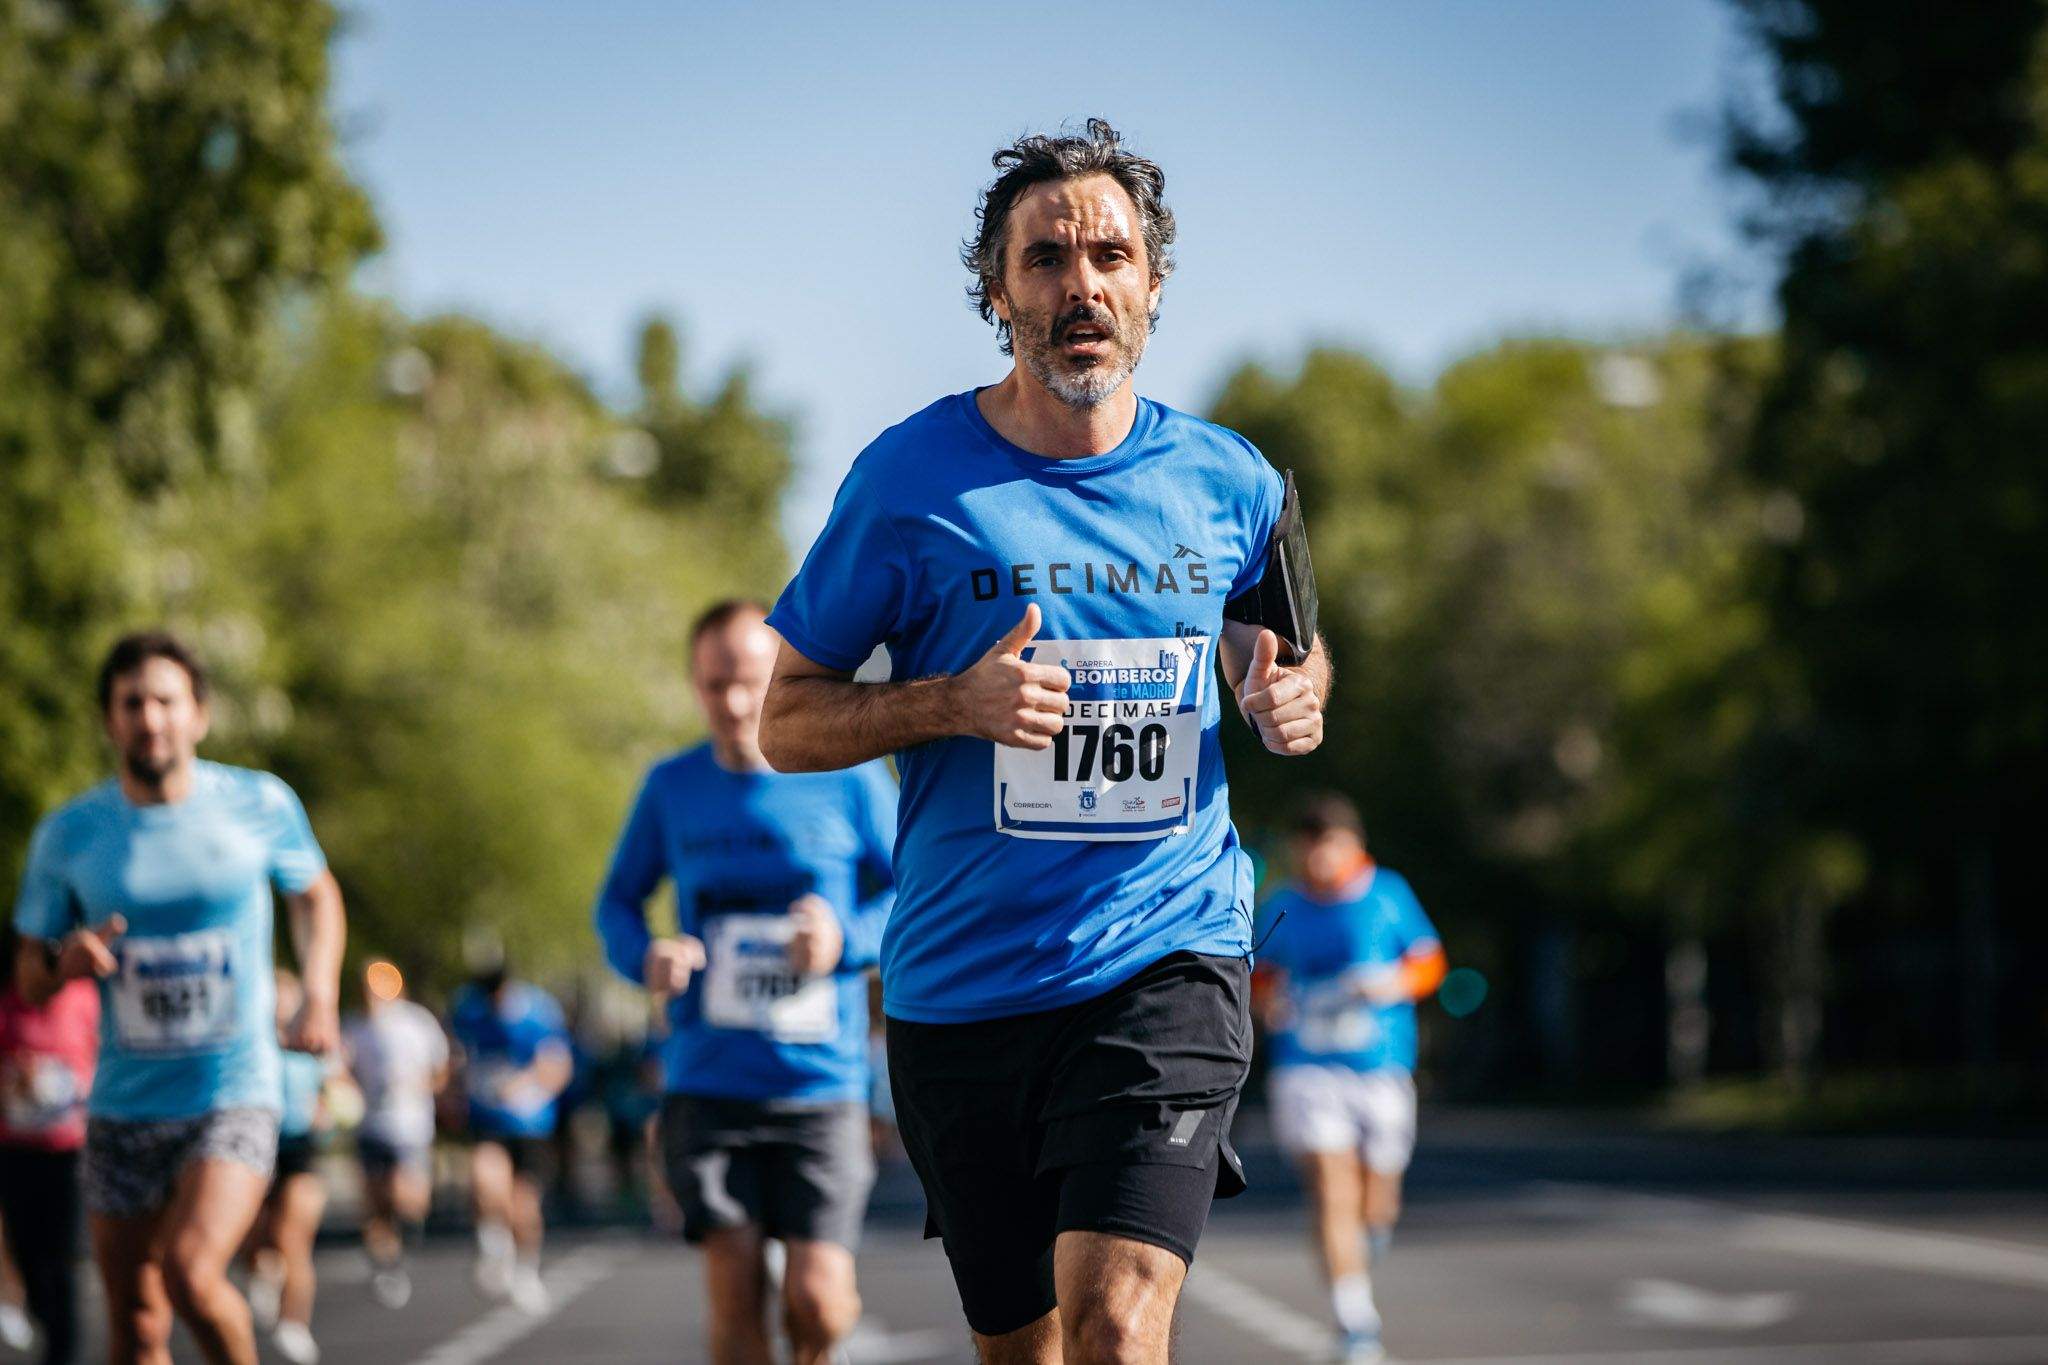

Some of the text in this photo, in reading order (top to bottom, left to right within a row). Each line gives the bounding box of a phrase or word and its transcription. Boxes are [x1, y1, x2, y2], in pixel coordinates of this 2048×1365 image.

[971, 563, 1209, 601] DECIMAS
[1077, 660, 1114, 668] CARRERA
[1075, 668, 1175, 685] BOMBEROS
[1131, 683, 1176, 699] MADRID
[1052, 723, 1168, 782] 1760
